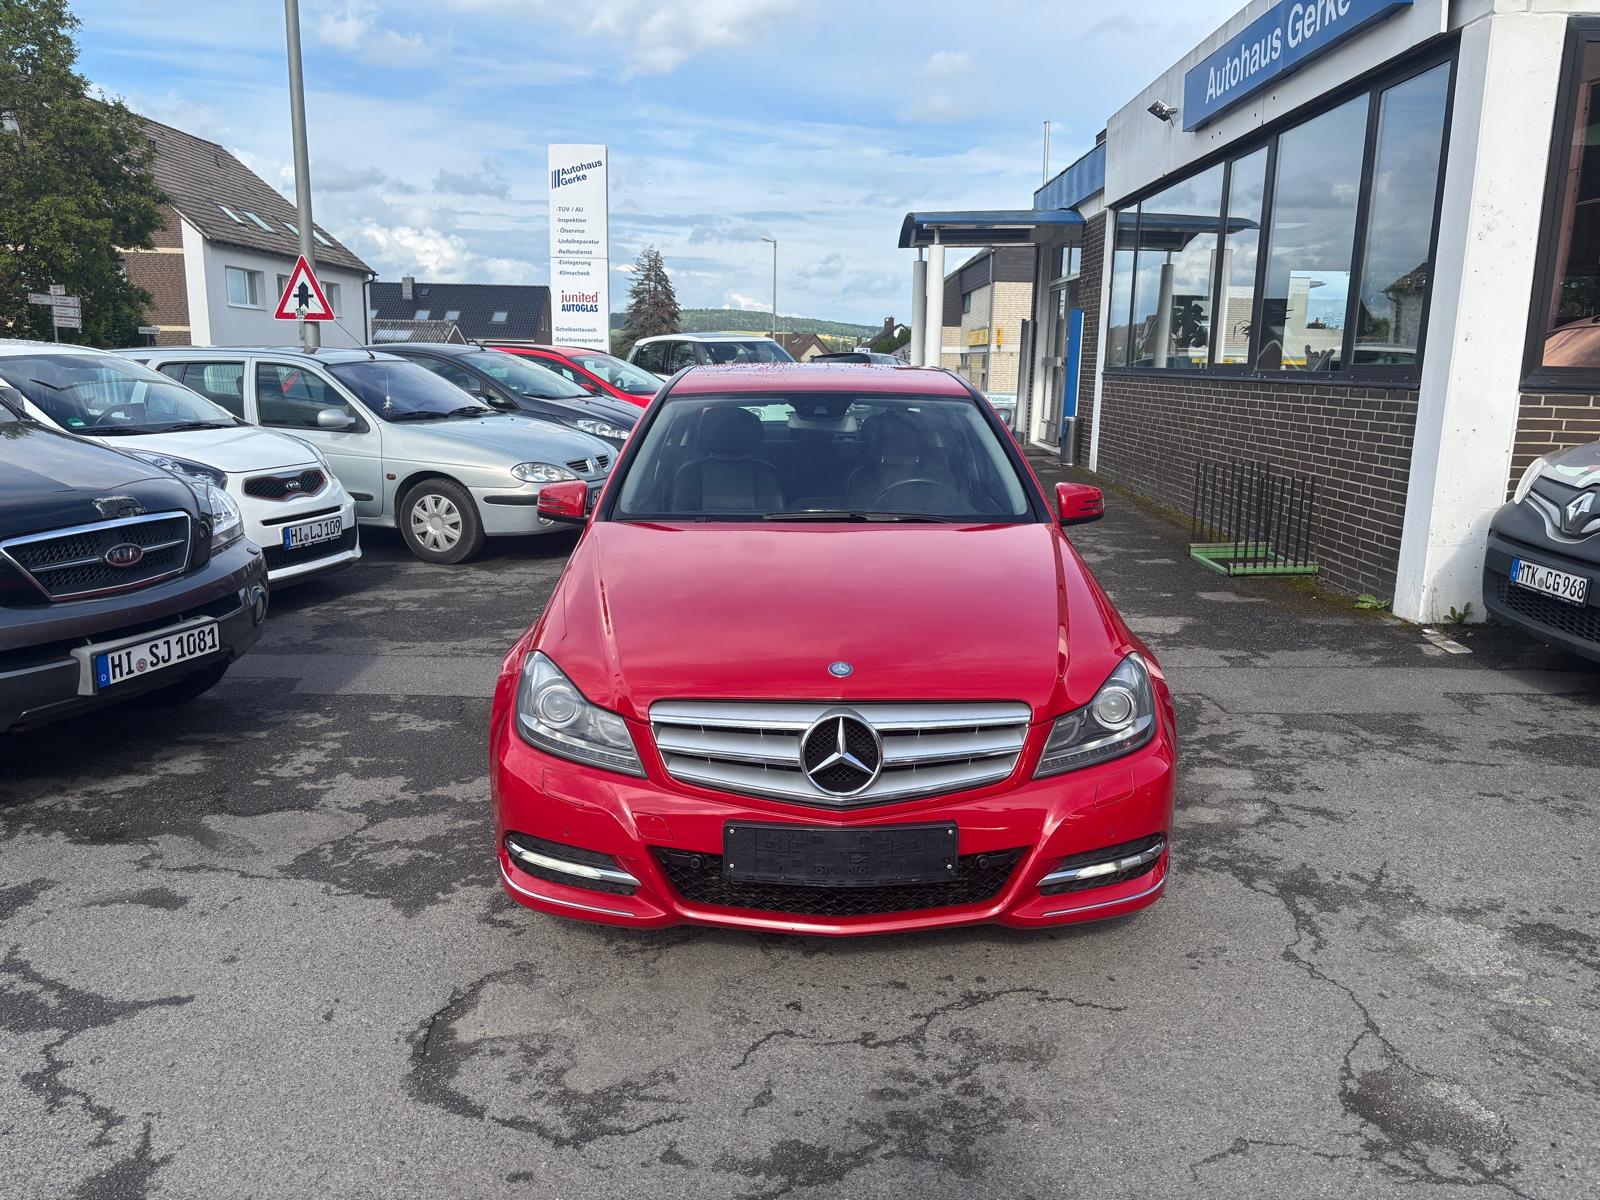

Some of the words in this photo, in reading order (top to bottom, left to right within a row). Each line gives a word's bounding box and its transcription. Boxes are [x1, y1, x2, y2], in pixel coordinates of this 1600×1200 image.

[1206, 27, 1281, 104] Autohaus
[561, 159, 603, 176] Autohaus
[560, 173, 587, 186] Gerke
[561, 290, 599, 303] junited
[561, 304, 599, 312] AUTOGLAS
[290, 528, 303, 545] HI
[1517, 562, 1539, 586] MTK
[1562, 576, 1586, 600] 968
[110, 651, 135, 680] HI
[175, 626, 217, 660] 1081
